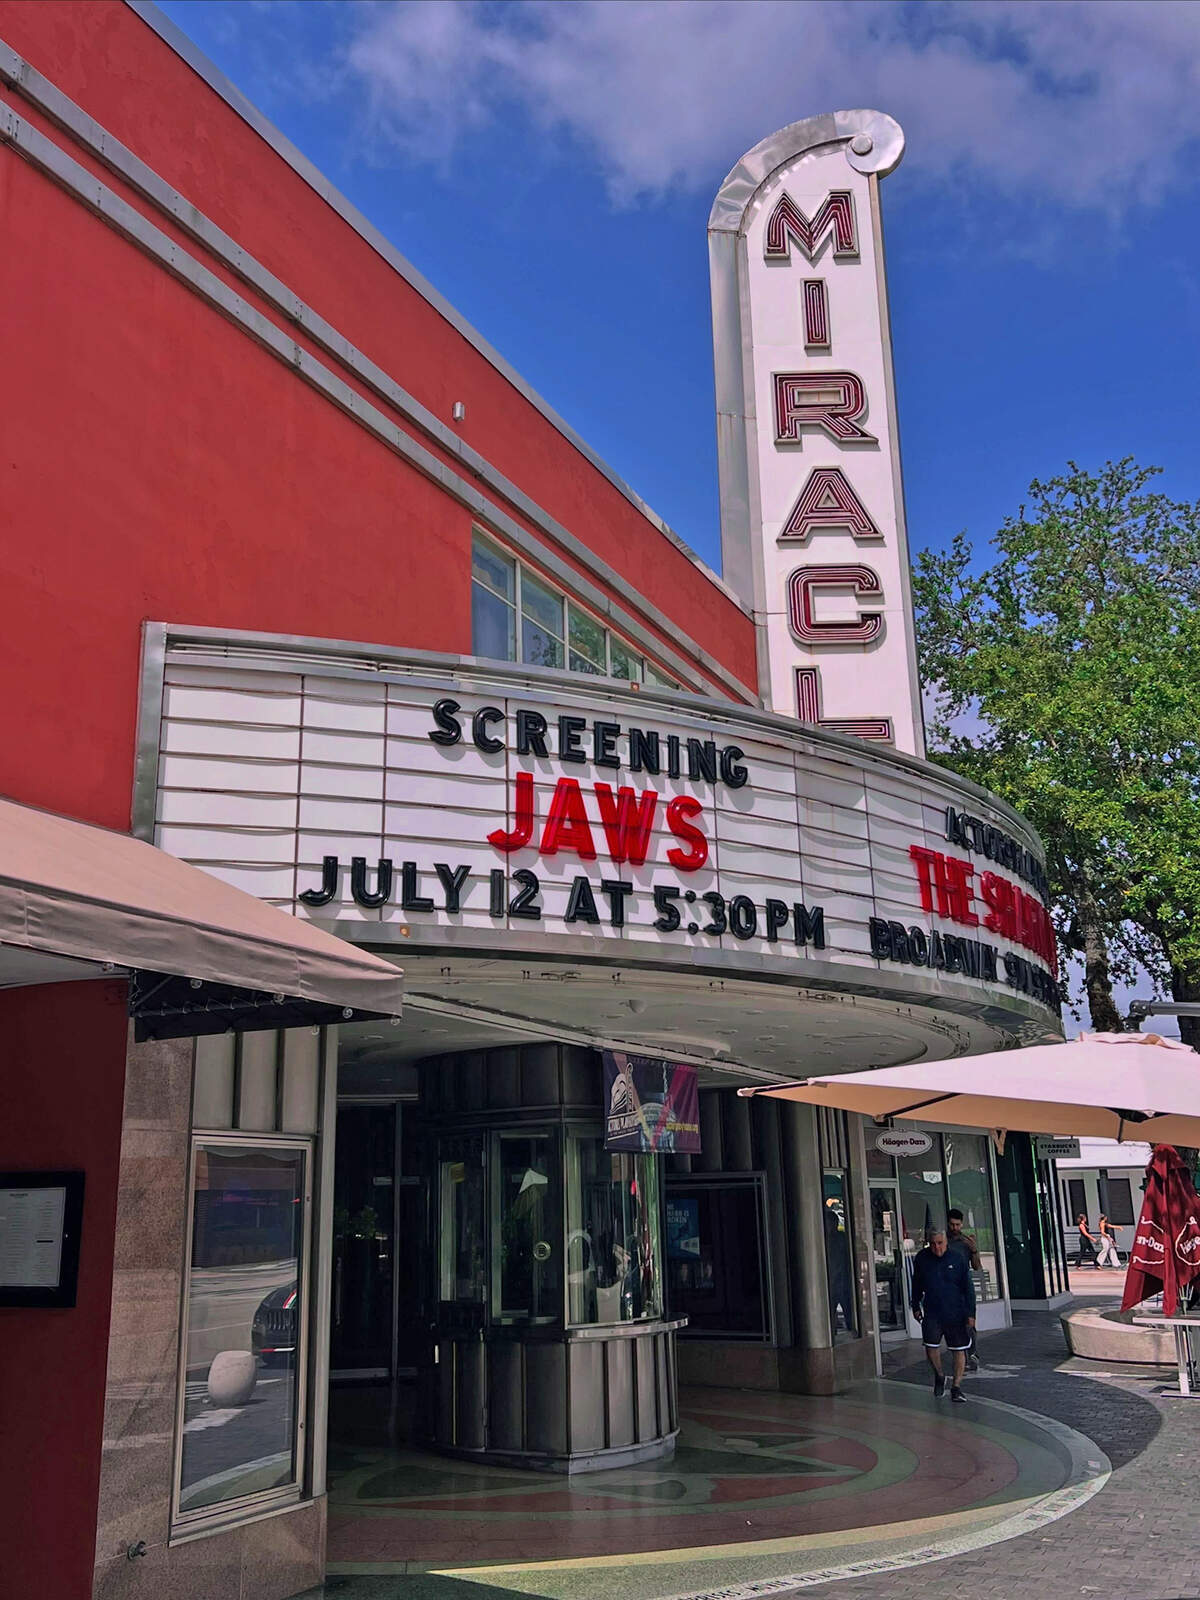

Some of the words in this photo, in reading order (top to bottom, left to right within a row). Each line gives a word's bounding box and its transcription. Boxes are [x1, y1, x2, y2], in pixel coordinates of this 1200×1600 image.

[428, 699, 748, 788] SCREENING
[487, 771, 708, 873] JAWS
[299, 856, 472, 914] JULY
[490, 868, 542, 921] 12
[564, 875, 633, 928] AT
[910, 844, 979, 928] THE
